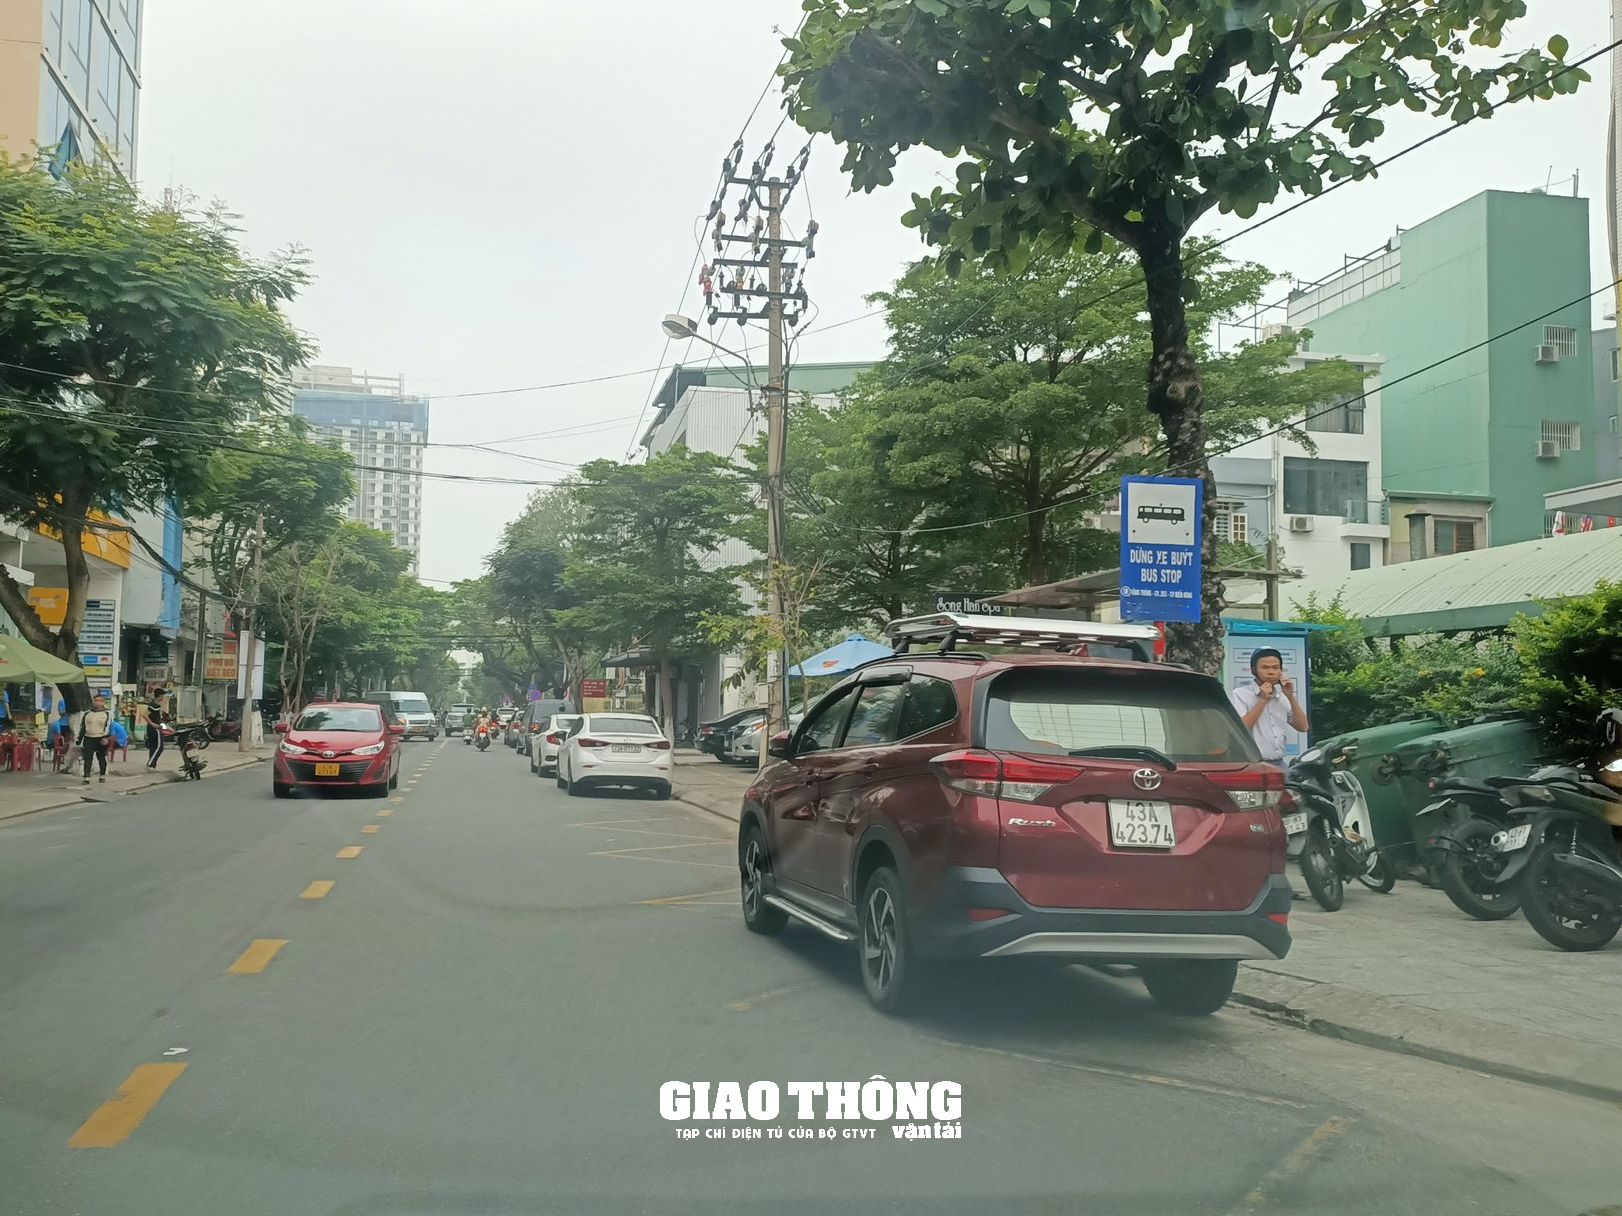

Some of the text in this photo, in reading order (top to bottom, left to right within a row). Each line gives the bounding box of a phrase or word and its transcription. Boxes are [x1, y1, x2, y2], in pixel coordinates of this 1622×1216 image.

[1130, 546, 1193, 566] DỪNG XE BUÝT
[1140, 568, 1182, 584] BUS STOP
[936, 597, 963, 613] Song
[963, 597, 980, 612] Han
[1125, 801, 1158, 823] 43A
[1008, 817, 1057, 828] Rush
[1115, 822, 1174, 845] 423.74
